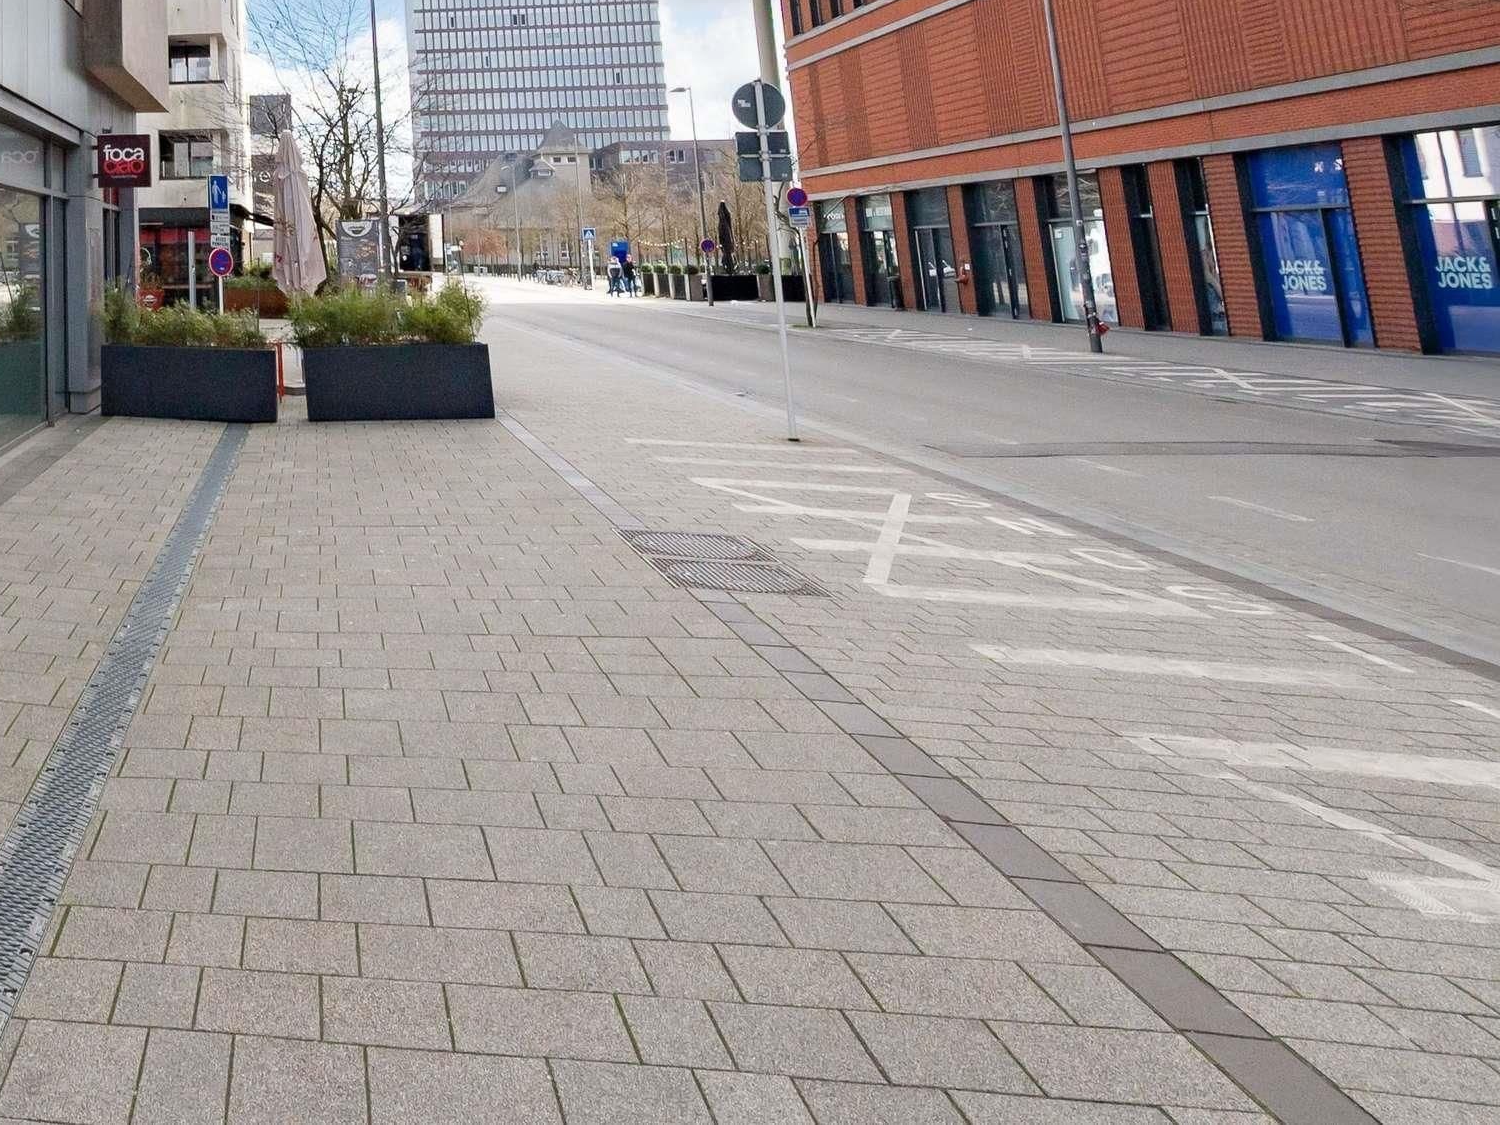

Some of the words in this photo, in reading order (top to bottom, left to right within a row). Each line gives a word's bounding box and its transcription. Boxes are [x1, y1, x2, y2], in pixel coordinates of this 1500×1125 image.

[103, 144, 144, 161] foca
[1282, 275, 1327, 291] JONES
[1438, 272, 1493, 289] JONES
